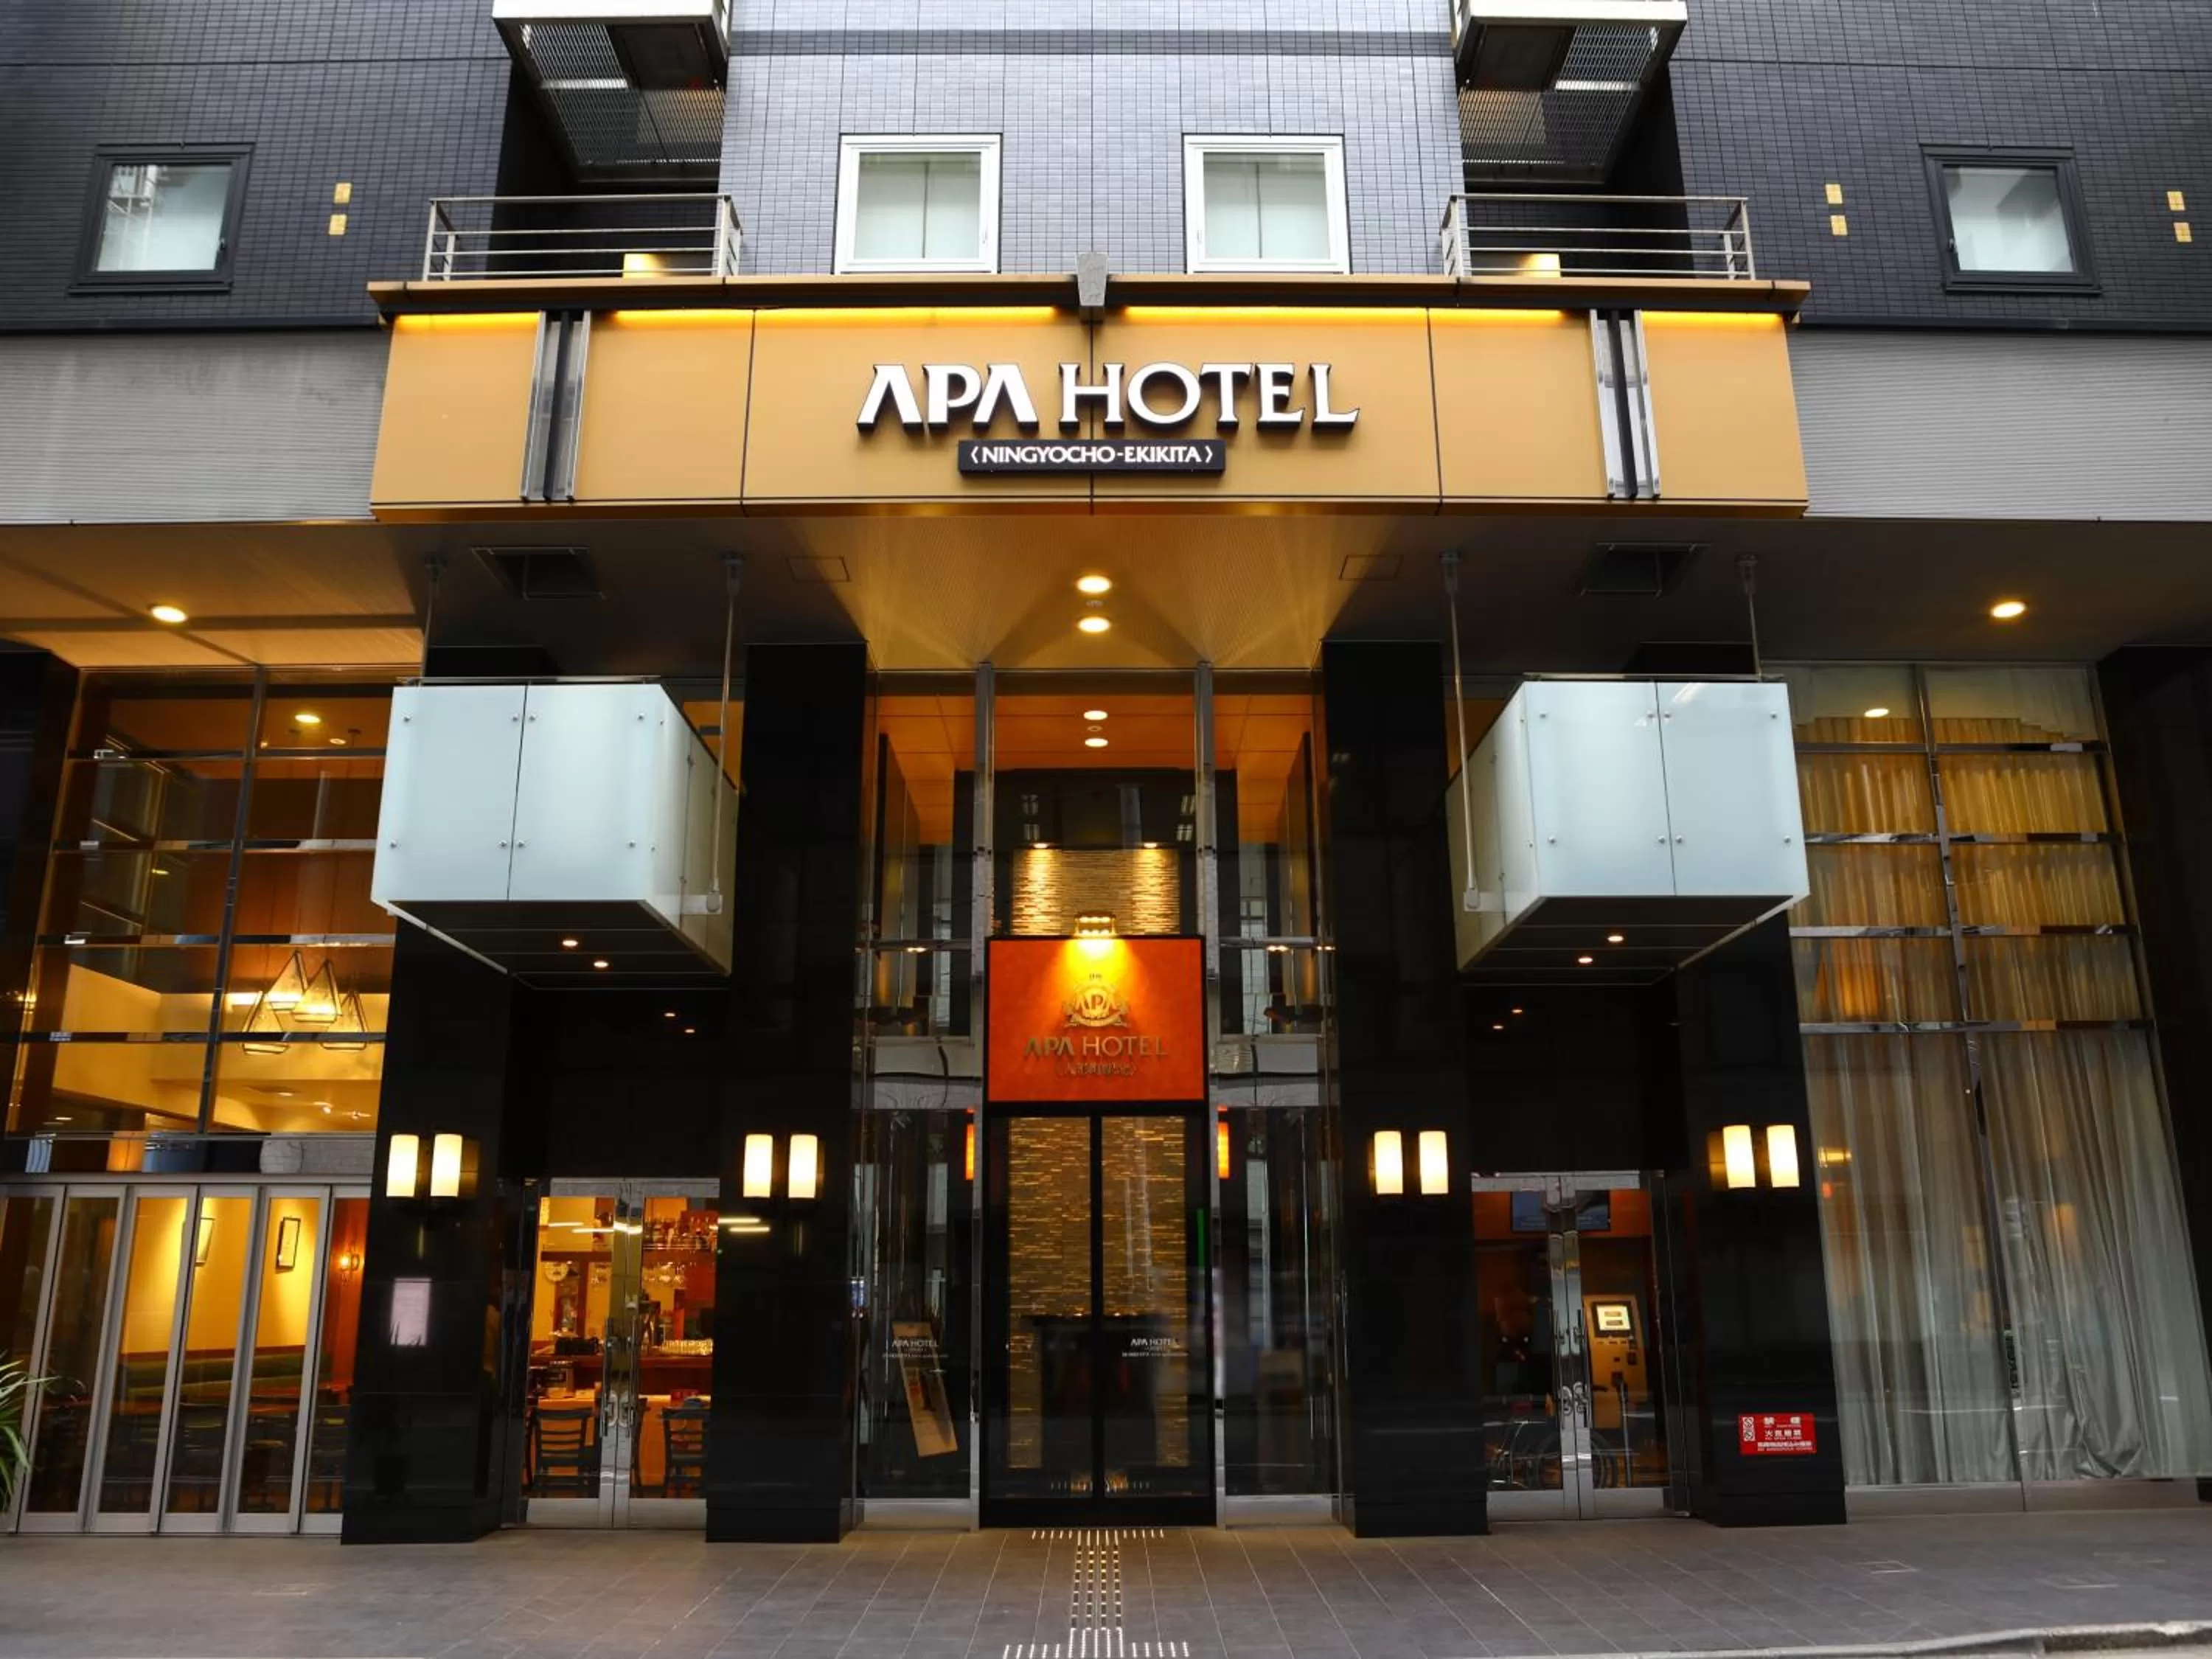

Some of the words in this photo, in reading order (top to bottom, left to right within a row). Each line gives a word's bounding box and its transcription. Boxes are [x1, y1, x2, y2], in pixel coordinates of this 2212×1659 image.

[855, 363, 1040, 430] APA
[1059, 361, 1360, 430] HOTEL
[1023, 1036, 1075, 1057] APA
[1082, 1035, 1169, 1057] HOTEL
